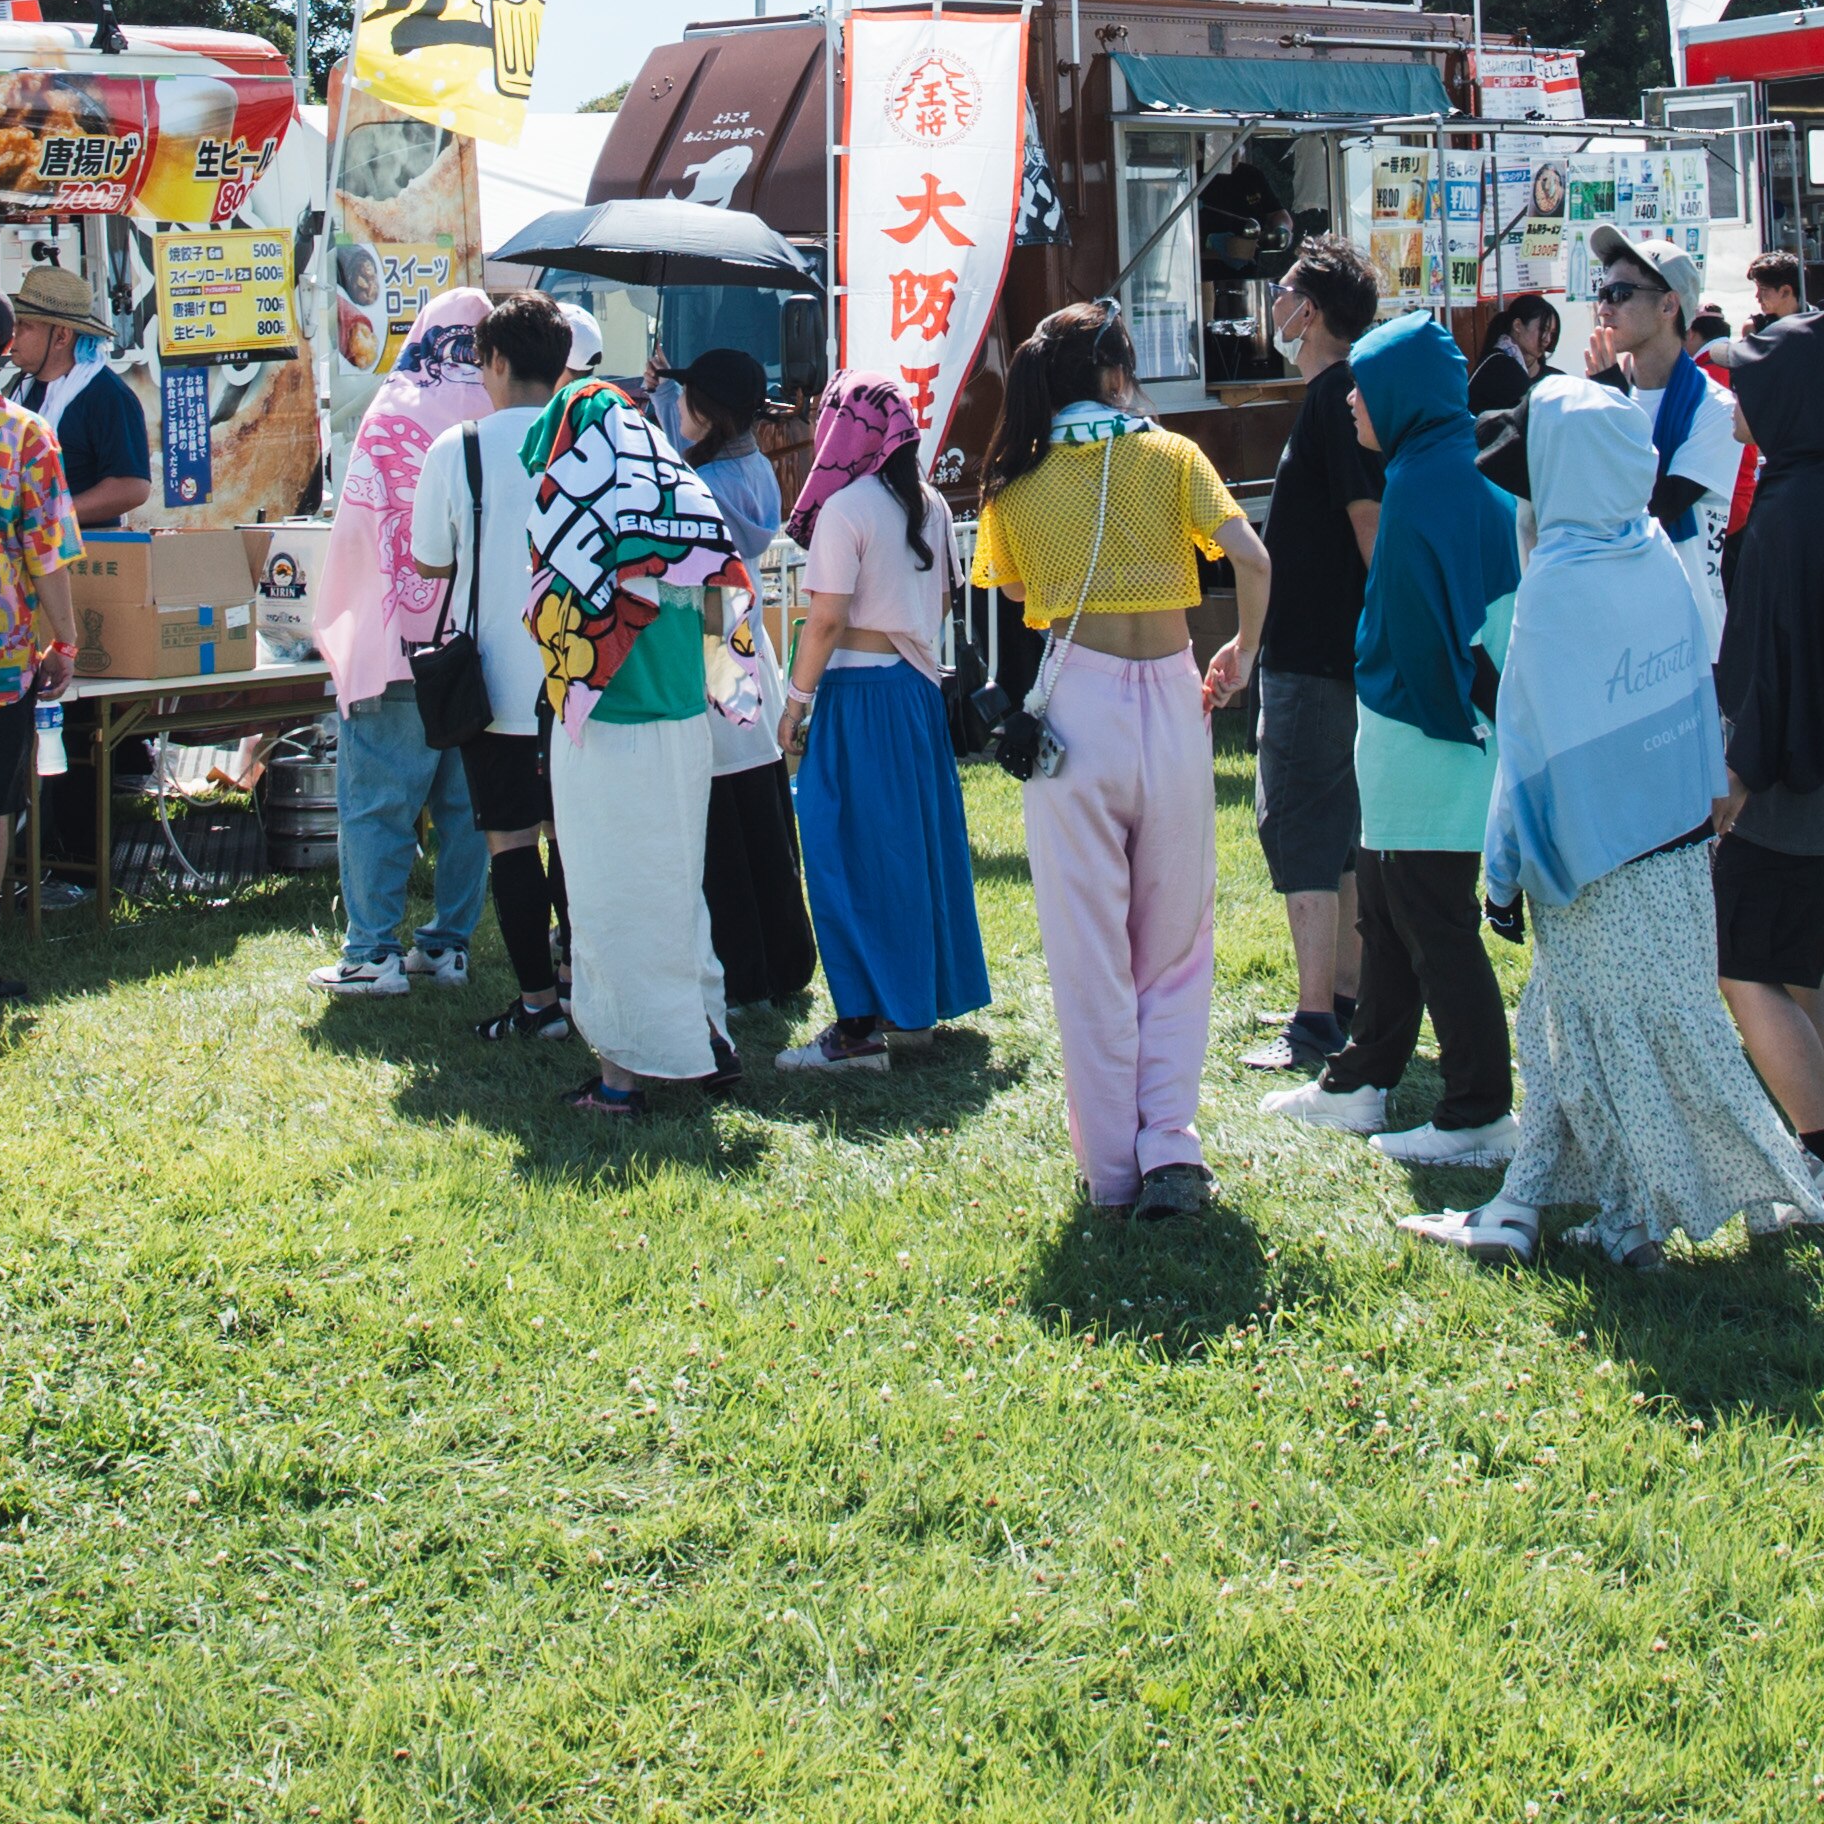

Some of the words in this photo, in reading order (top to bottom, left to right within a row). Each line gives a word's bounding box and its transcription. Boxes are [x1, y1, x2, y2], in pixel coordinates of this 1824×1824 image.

[916, 81, 947, 137] 王将
[712, 111, 751, 125] ようこそ
[682, 127, 765, 143] あんこうの世界へ
[39, 137, 137, 177] 唐揚げ
[195, 140, 274, 178] 生ビール
[1380, 156, 1421, 174] 一番搾り
[1376, 187, 1400, 209] ¥800
[1634, 203, 1657, 219] ¥400
[169, 246, 203, 262] 焼餃子
[170, 268, 233, 284] スイーツロール
[384, 256, 449, 285] スイーツ
[173, 301, 206, 318] 唐揚げ
[174, 324, 216, 341] 生ビール
[177, 377, 188, 451] アルコール類の
[270, 587, 296, 598] KIRIN
